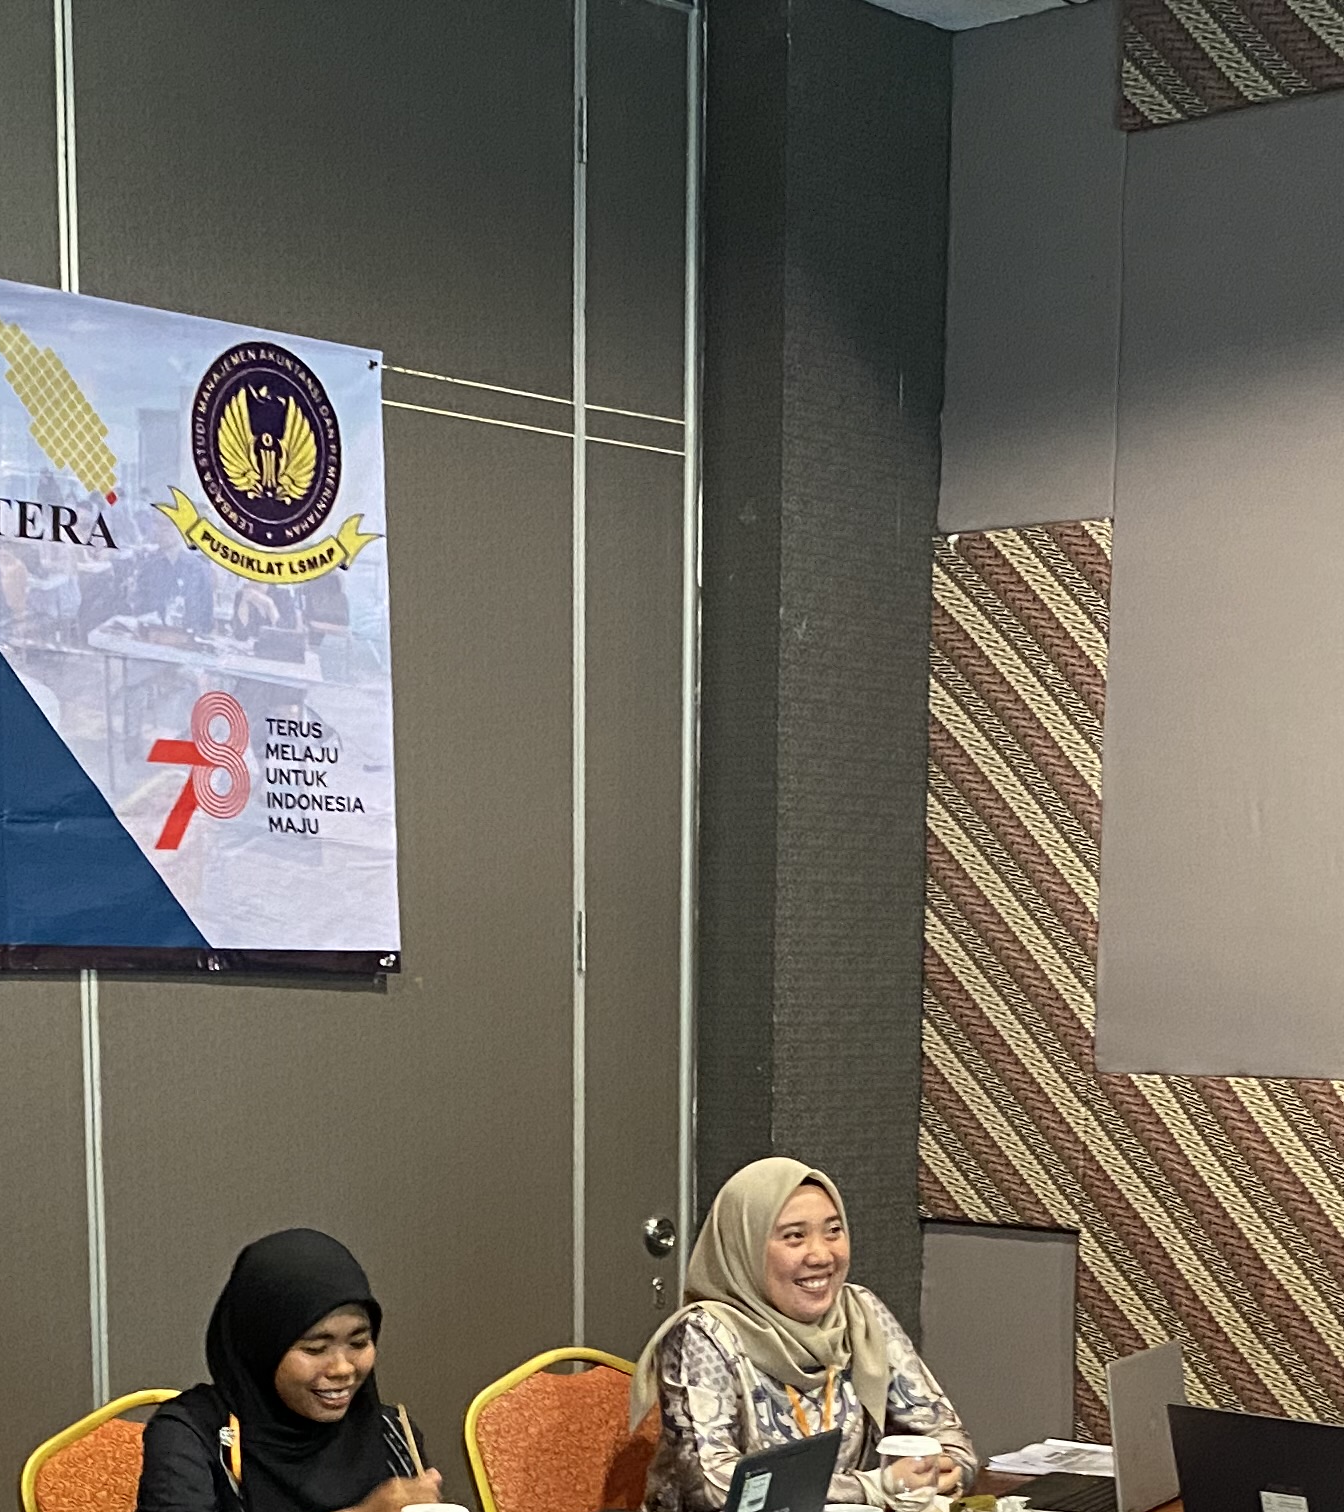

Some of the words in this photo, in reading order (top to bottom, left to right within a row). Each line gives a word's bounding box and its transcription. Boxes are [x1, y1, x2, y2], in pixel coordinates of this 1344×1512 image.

[318, 404, 335, 439] DAN
[201, 530, 284, 576] PUSDIKLAT
[289, 547, 335, 575] LSMAP
[266, 718, 323, 739] TERUS
[265, 743, 339, 765] MELAJU
[265, 767, 328, 788] UNTUK
[266, 792, 365, 815] INDONESIA
[268, 815, 319, 836] MAJU
